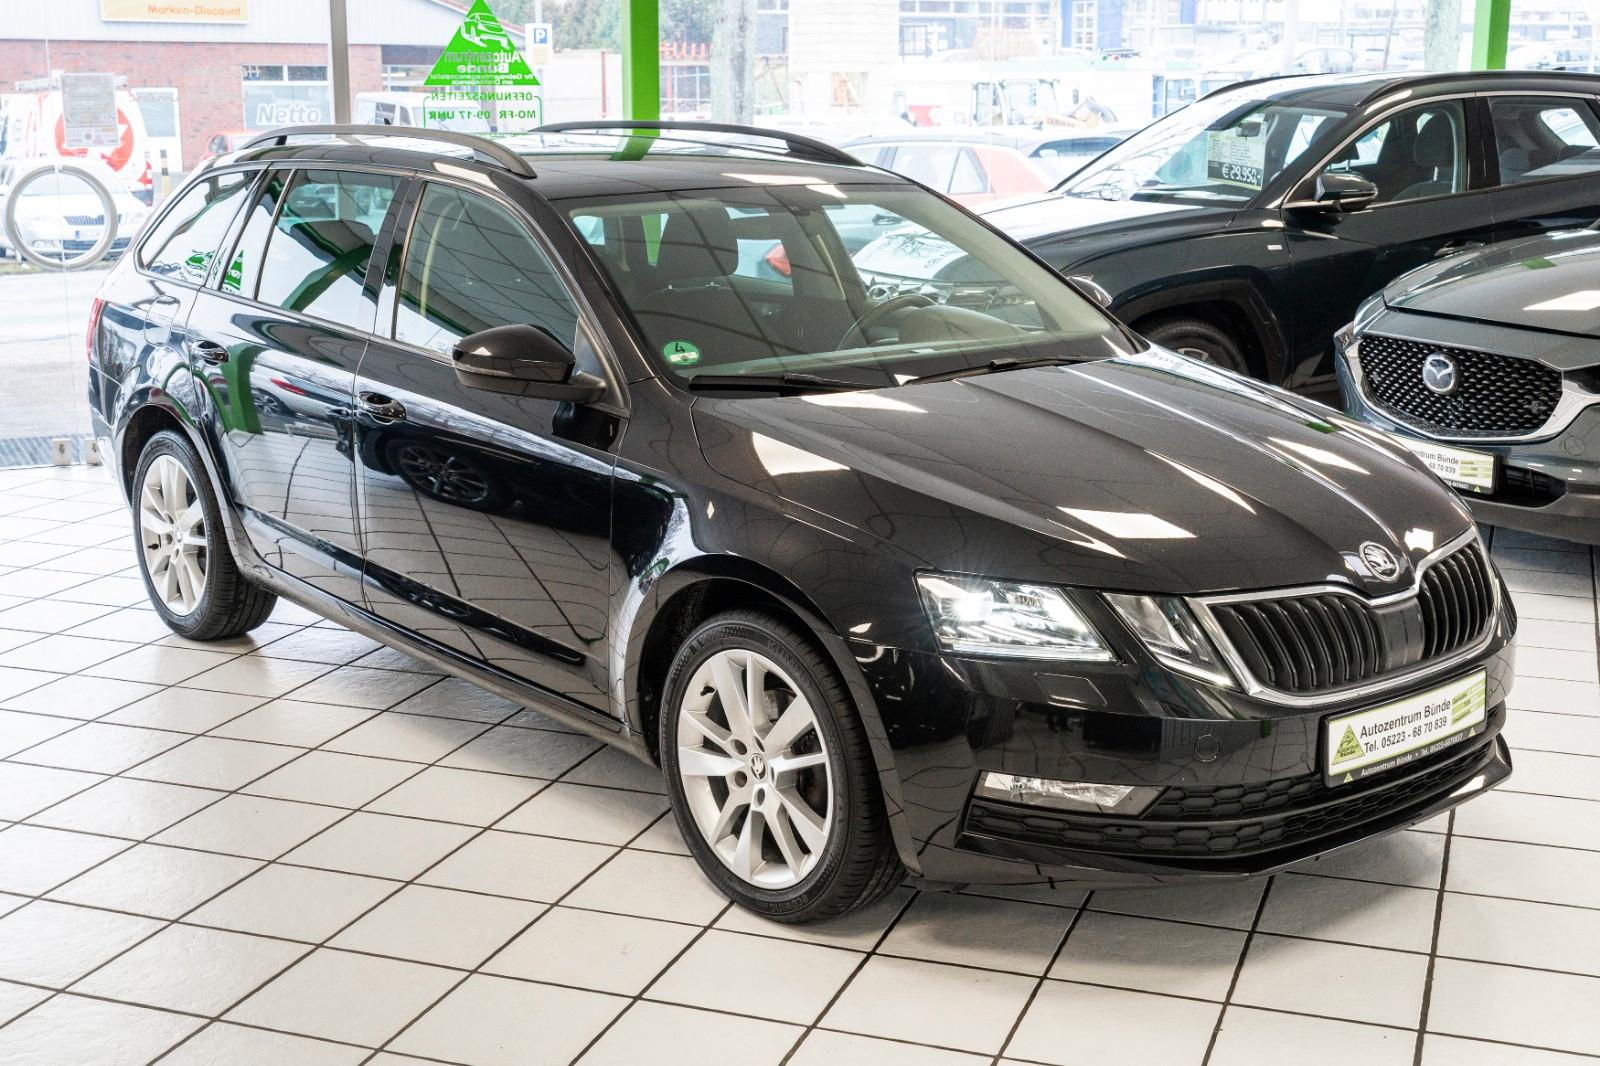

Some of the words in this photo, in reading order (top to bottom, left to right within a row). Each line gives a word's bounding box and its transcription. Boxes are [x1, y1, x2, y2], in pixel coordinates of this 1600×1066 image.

[147, 5, 241, 16] Marken-Discount
[536, 29, 546, 43] P
[257, 103, 321, 125] Netto
[675, 343, 685, 353] 4
[1360, 710, 1422, 739] Autozentrum
[1424, 699, 1451, 718] Bünde
[1364, 740, 1379, 754] Tel.
[1381, 731, 1406, 748] 05223
[1412, 725, 1422, 738] 68
[1424, 721, 1433, 734] 70
[1434, 716, 1448, 731] 839
